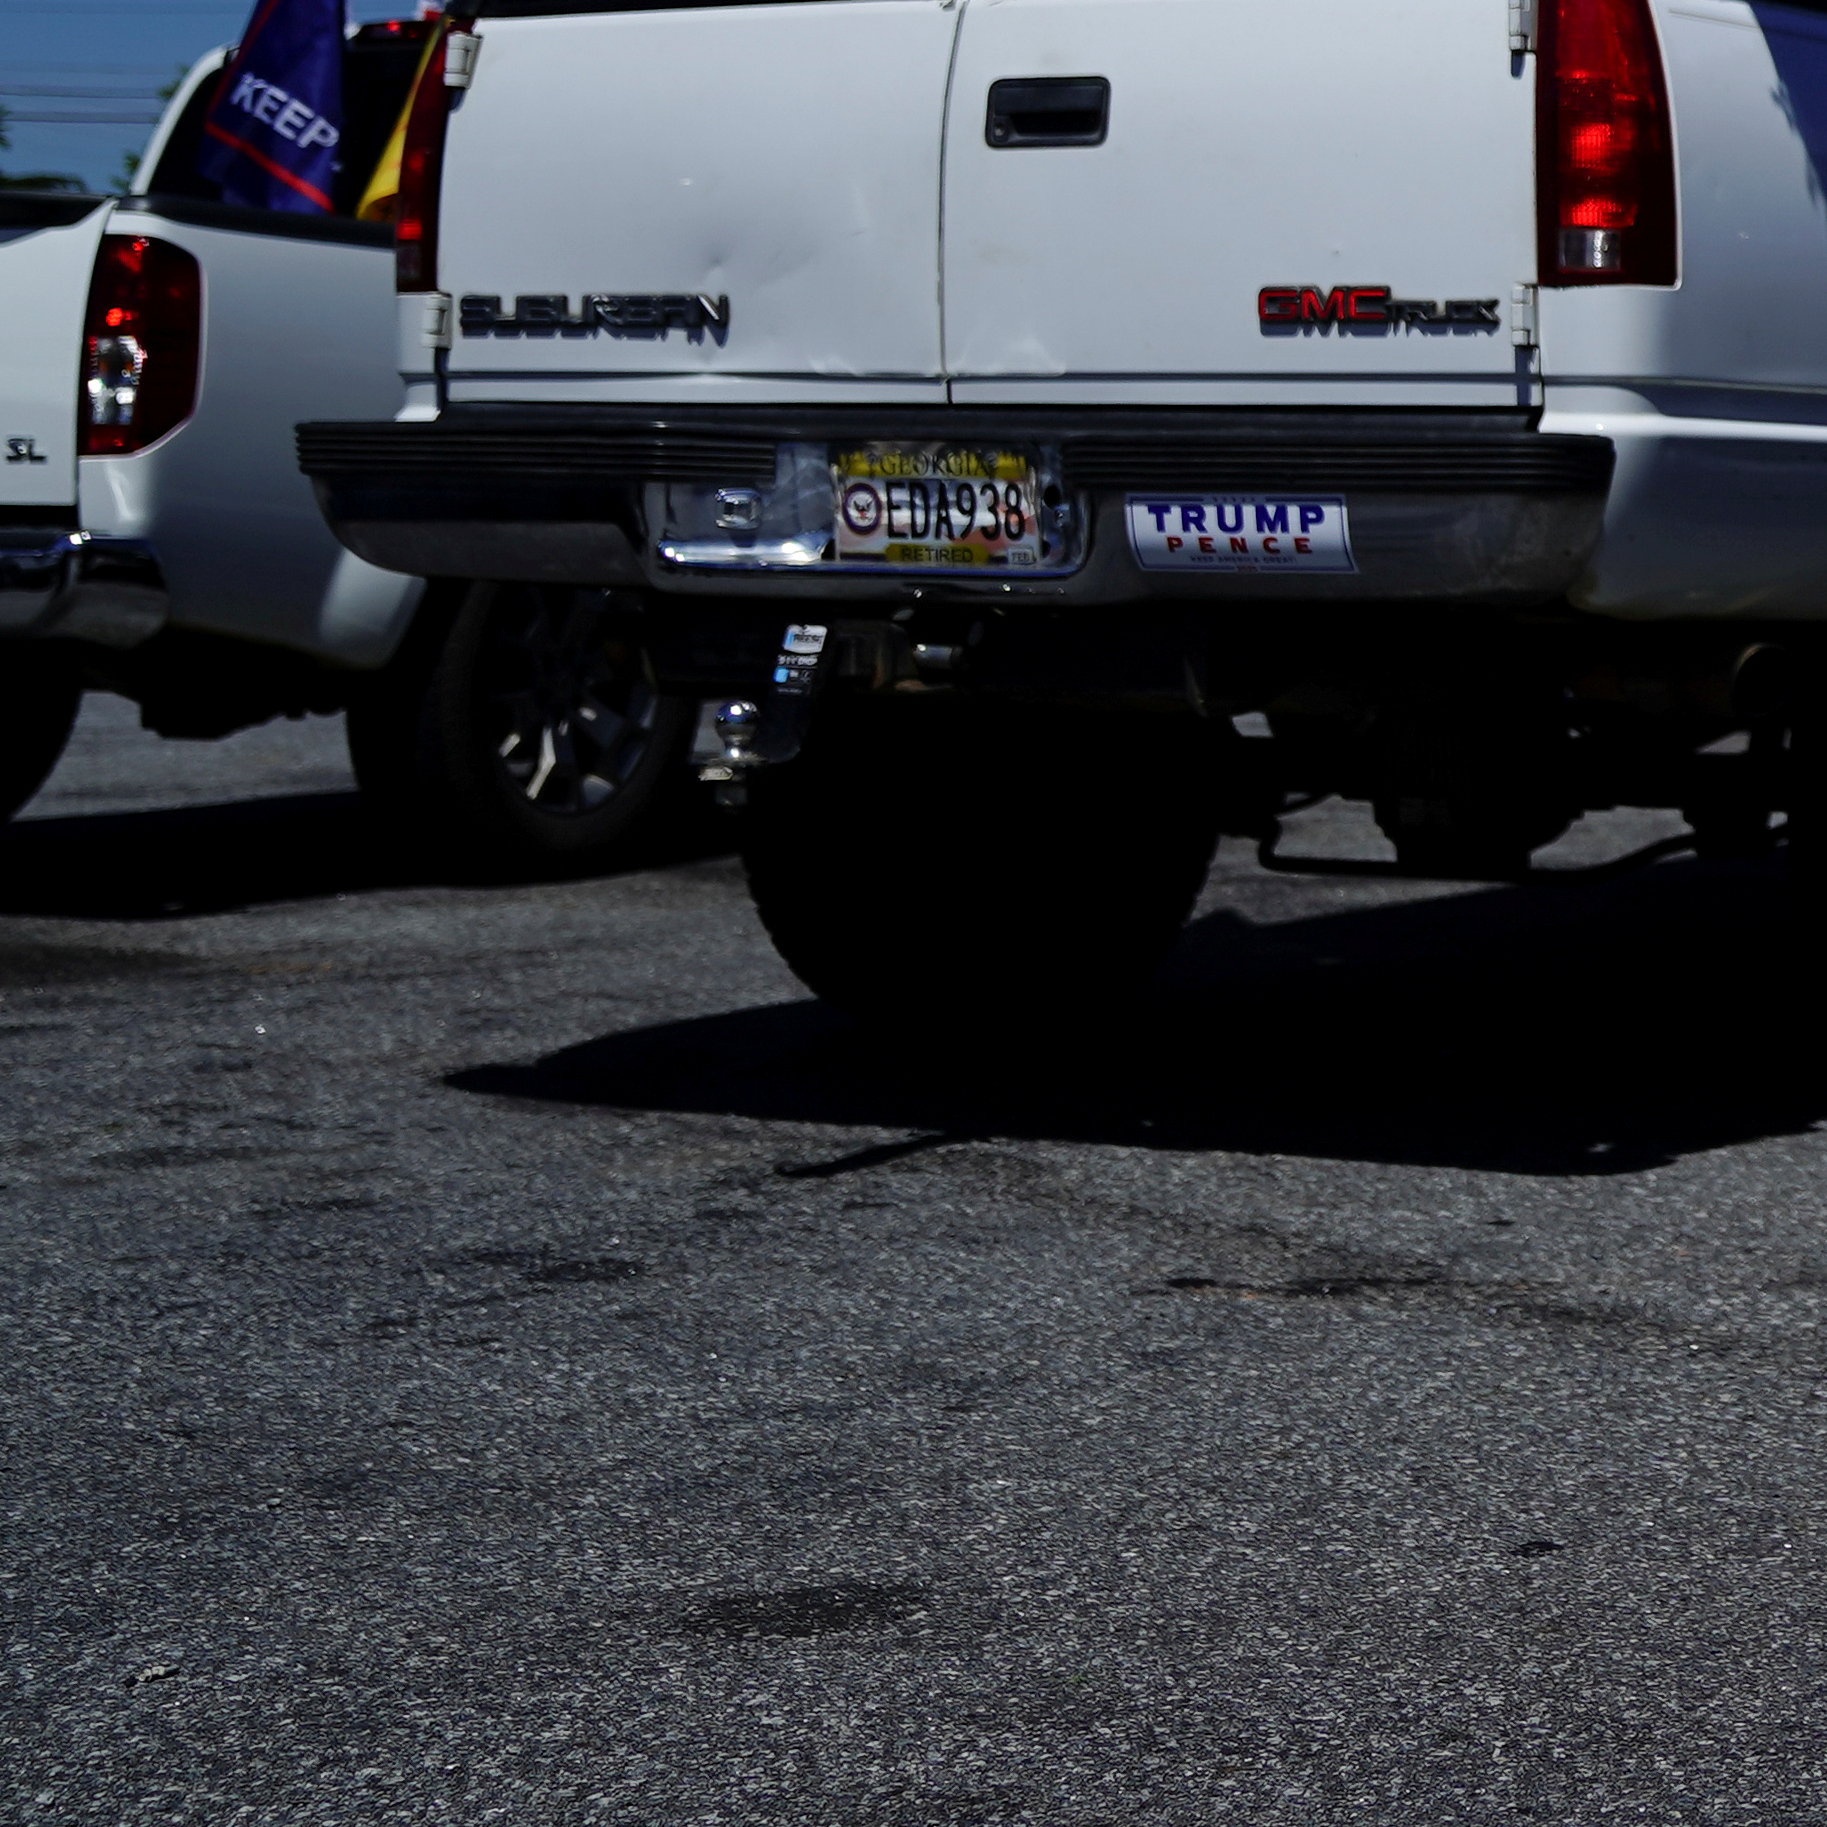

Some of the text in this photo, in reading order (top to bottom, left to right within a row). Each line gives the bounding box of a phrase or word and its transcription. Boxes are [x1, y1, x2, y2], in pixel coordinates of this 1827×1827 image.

[229, 72, 340, 148] KEEP
[460, 293, 730, 332] SUBURBAN
[1257, 285, 1391, 324] GMC
[6, 438, 48, 464] SL
[886, 481, 1025, 541] EDA938
[1147, 503, 1326, 534] TRUMP
[901, 548, 975, 563] RETIRED
[1166, 537, 1313, 554] PENCE
